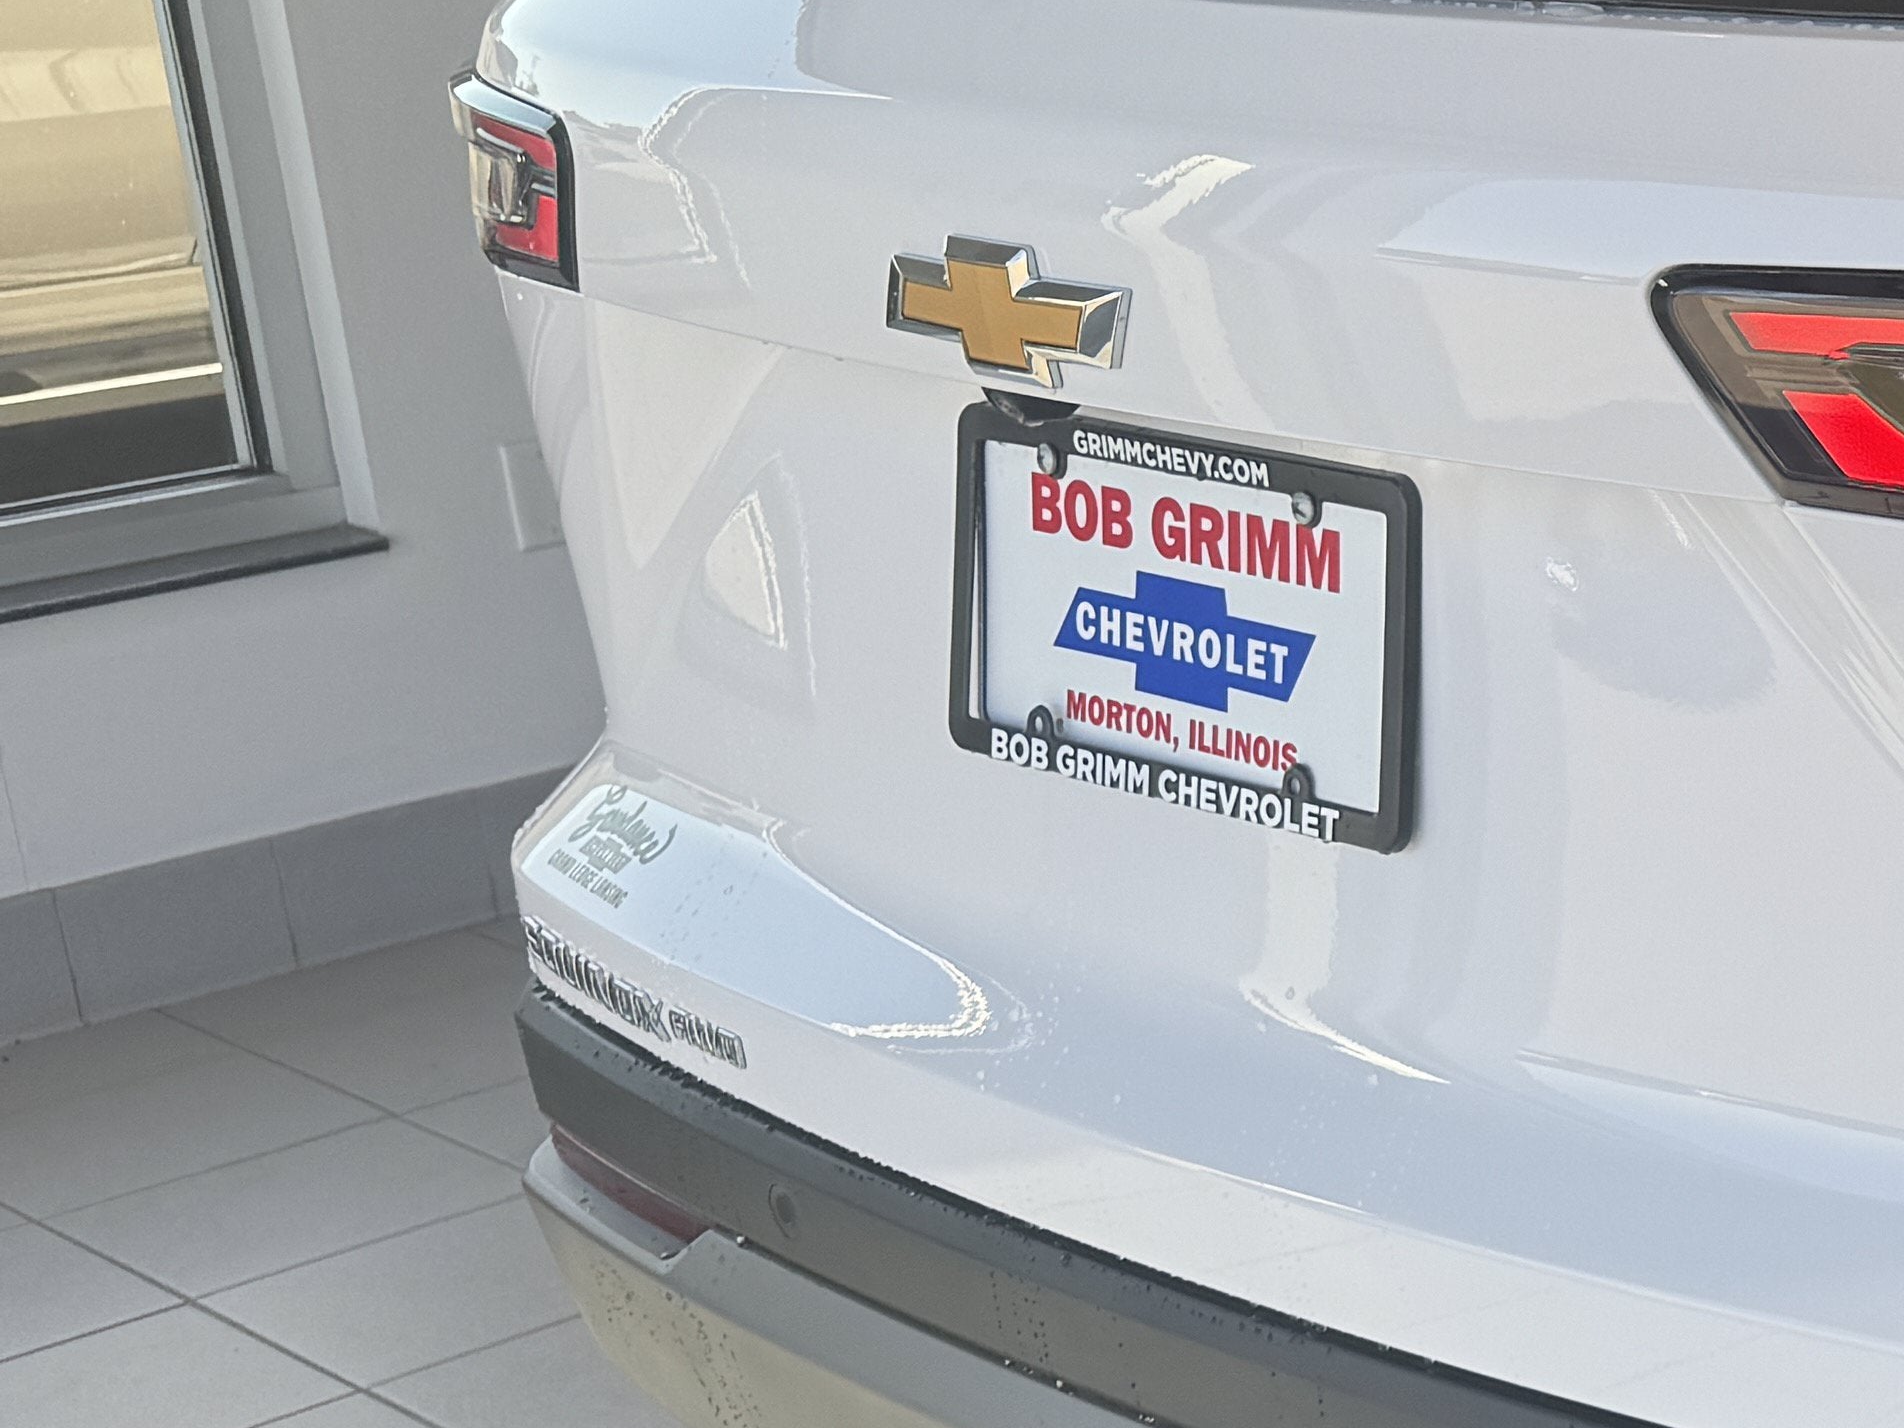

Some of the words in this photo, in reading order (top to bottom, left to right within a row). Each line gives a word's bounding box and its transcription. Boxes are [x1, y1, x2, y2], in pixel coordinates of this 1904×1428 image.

[1072, 429, 1271, 488] GRIMMCHEVY.COM
[1030, 472, 1134, 549] BOB
[1151, 496, 1341, 594] GRIMM
[1075, 601, 1289, 684] CHEVROLET
[1066, 688, 1180, 753] MORTON,
[1188, 718, 1299, 772] ILLINOIS
[990, 728, 1049, 771] BOB
[1055, 743, 1151, 797] GRIMM
[1158, 768, 1340, 842] CHEVROLET
